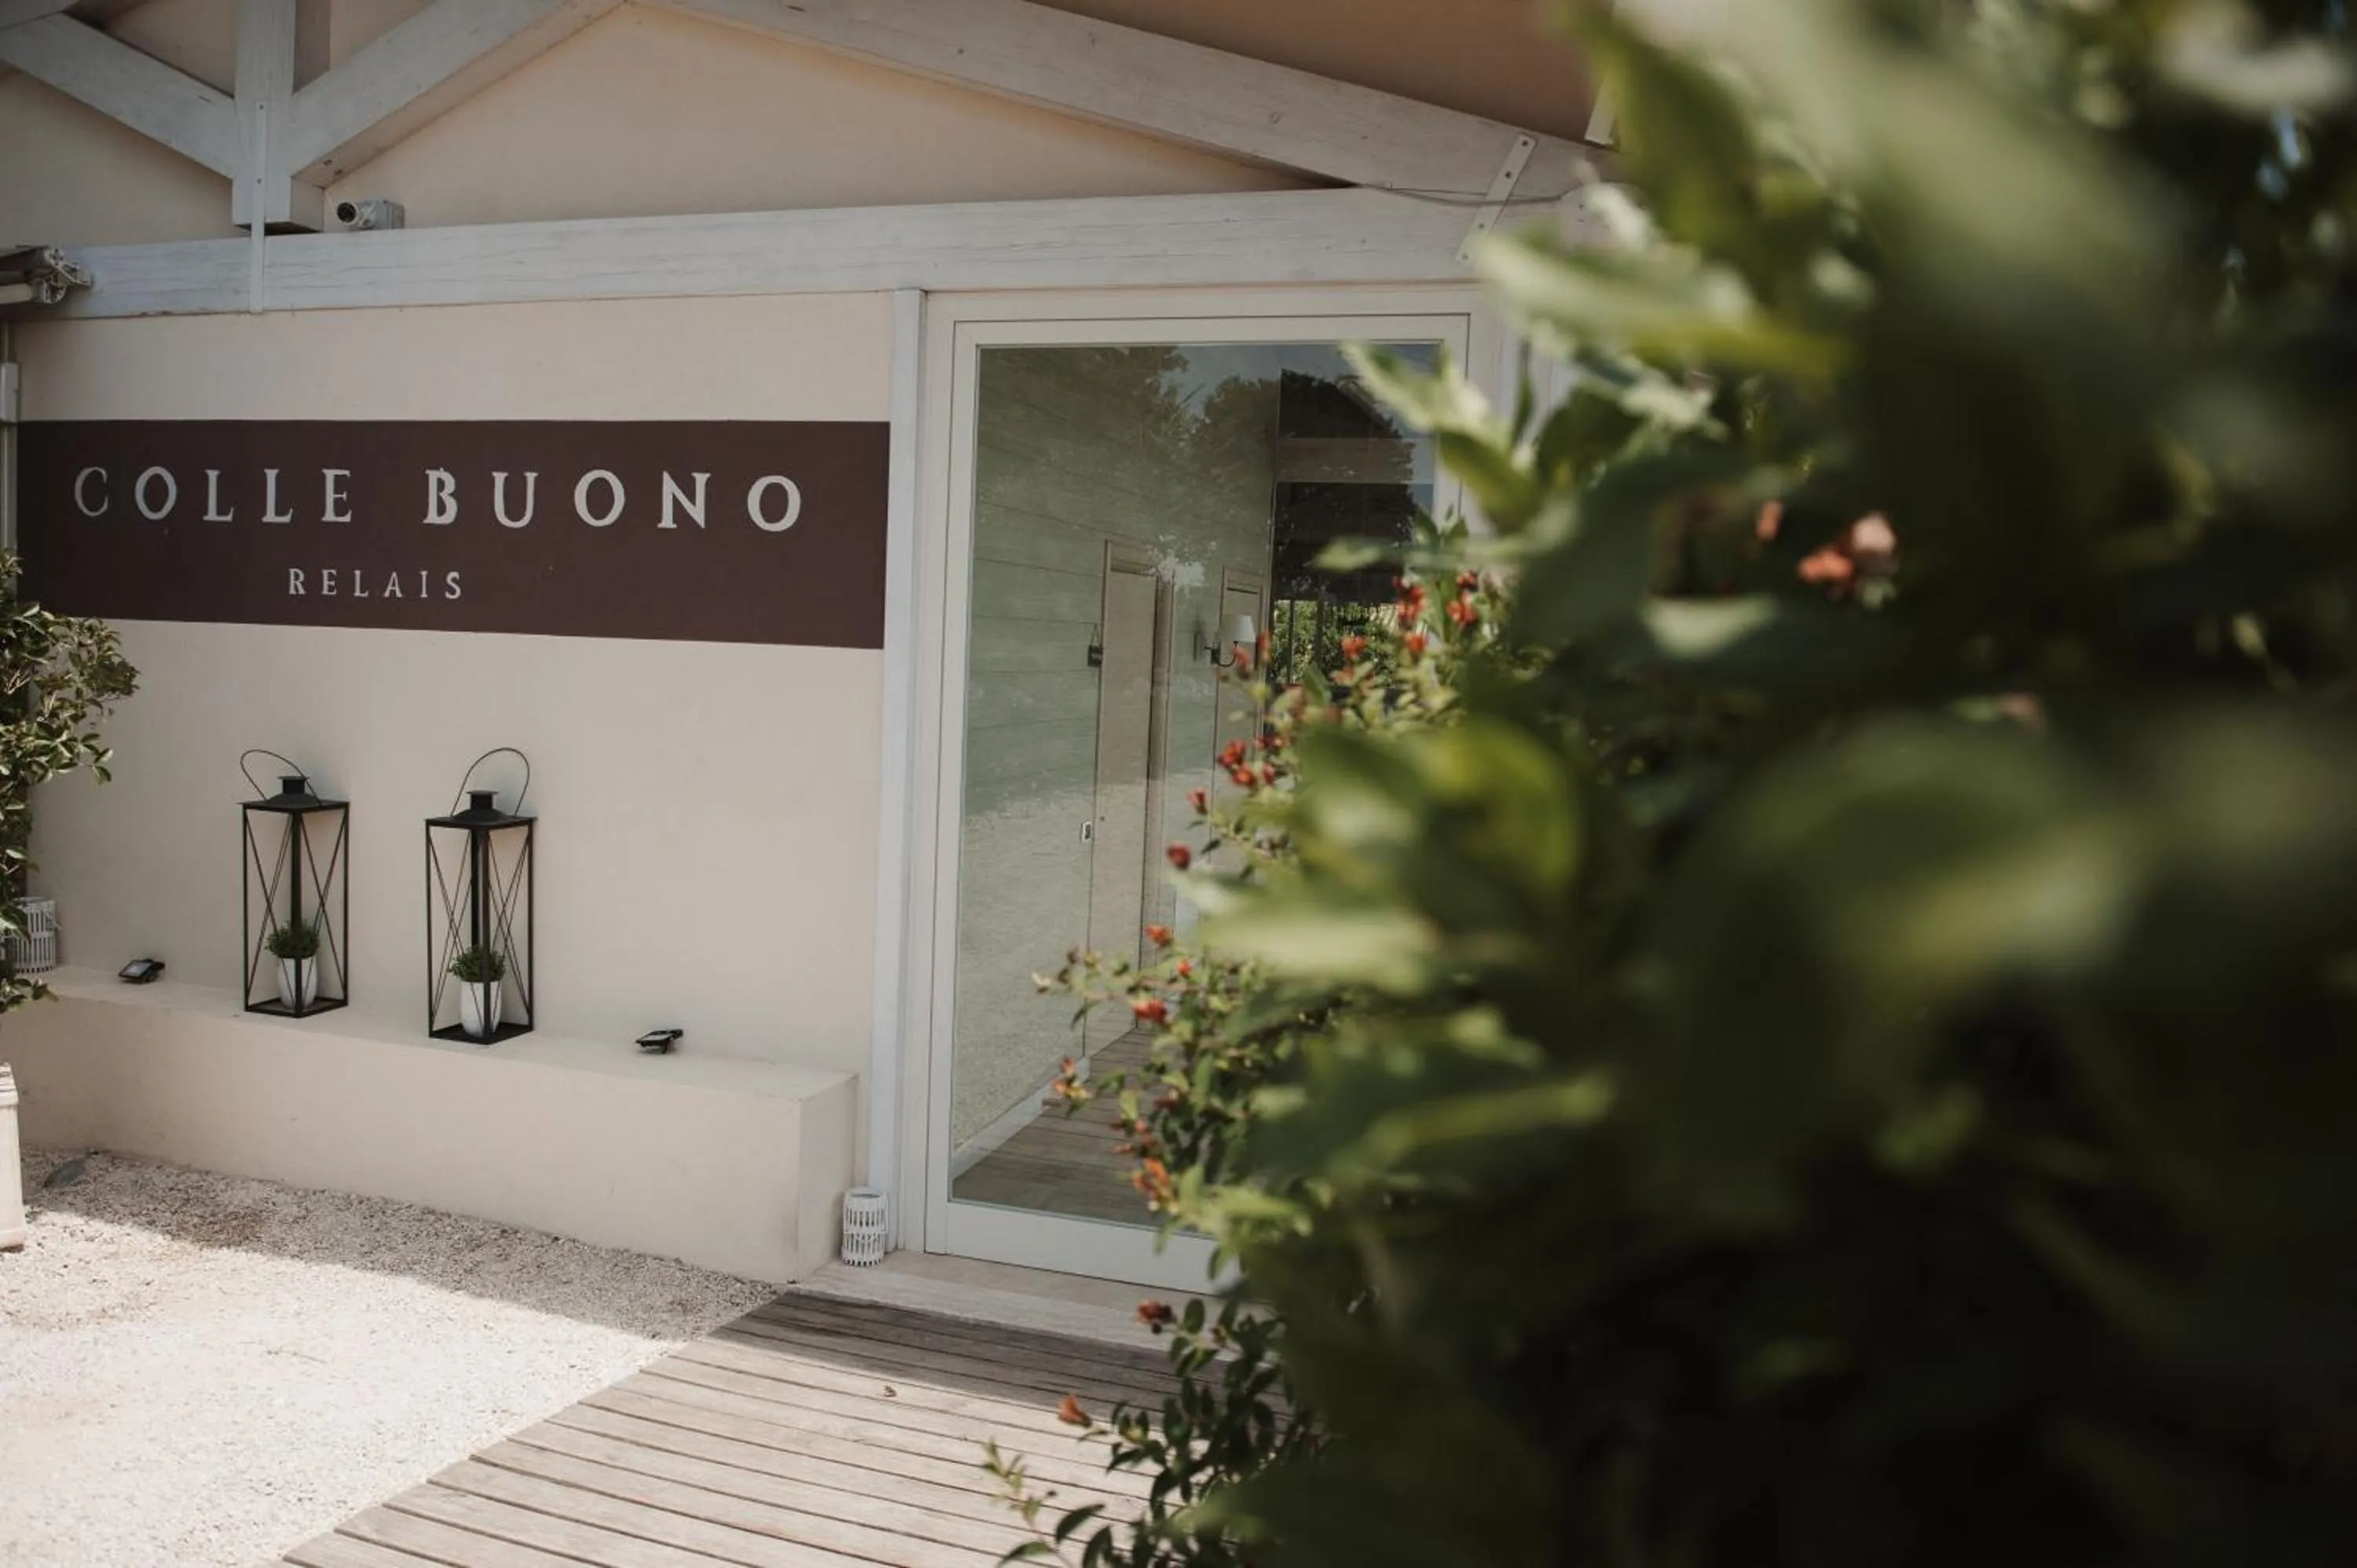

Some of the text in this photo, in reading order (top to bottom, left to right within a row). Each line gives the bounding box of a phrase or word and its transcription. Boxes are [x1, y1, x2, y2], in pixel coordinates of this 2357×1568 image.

[74, 465, 801, 532] COLLE BUONO
[288, 568, 462, 599] RELAIS
